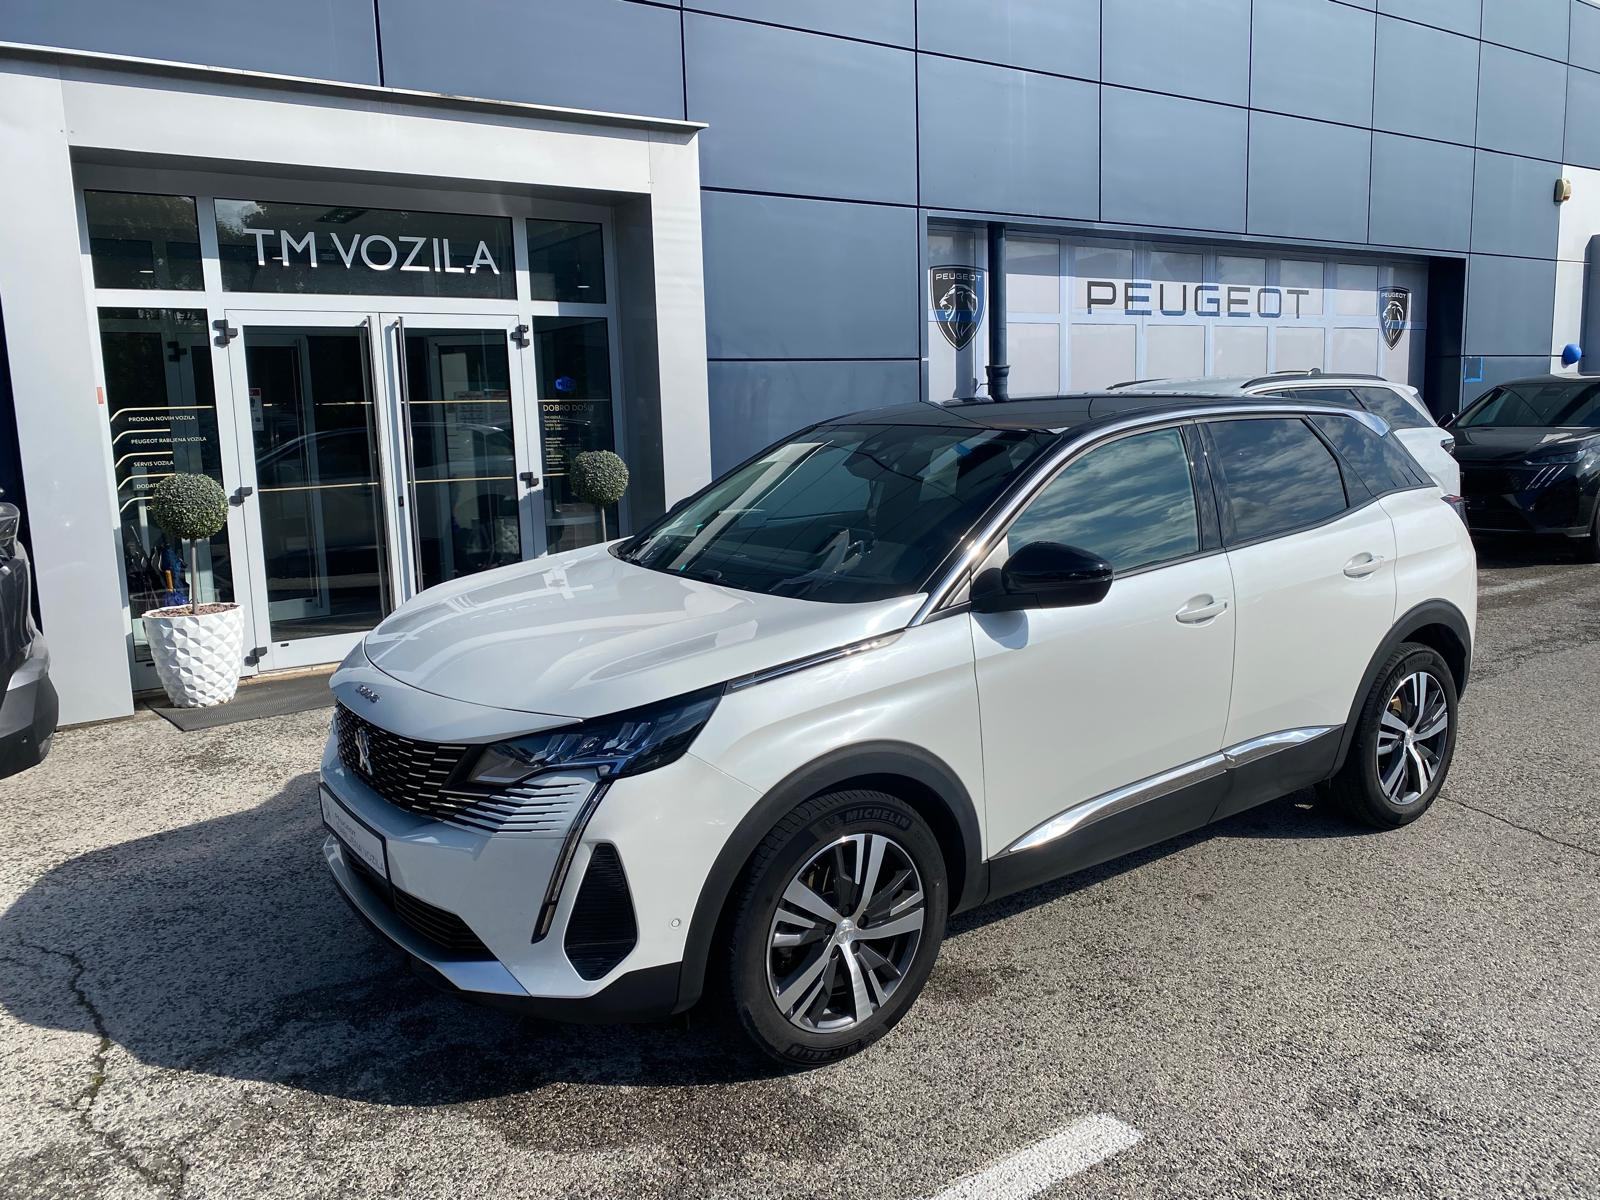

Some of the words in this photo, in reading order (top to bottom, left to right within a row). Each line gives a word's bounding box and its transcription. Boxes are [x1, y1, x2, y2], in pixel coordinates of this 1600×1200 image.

[243, 228, 317, 269] TM
[330, 232, 500, 275] VOZILA
[935, 272, 982, 282] PEUGEOT
[1087, 280, 1310, 319] PEUGEOT
[542, 404, 570, 412] DOBRO
[846, 807, 911, 831] MICHELIN
